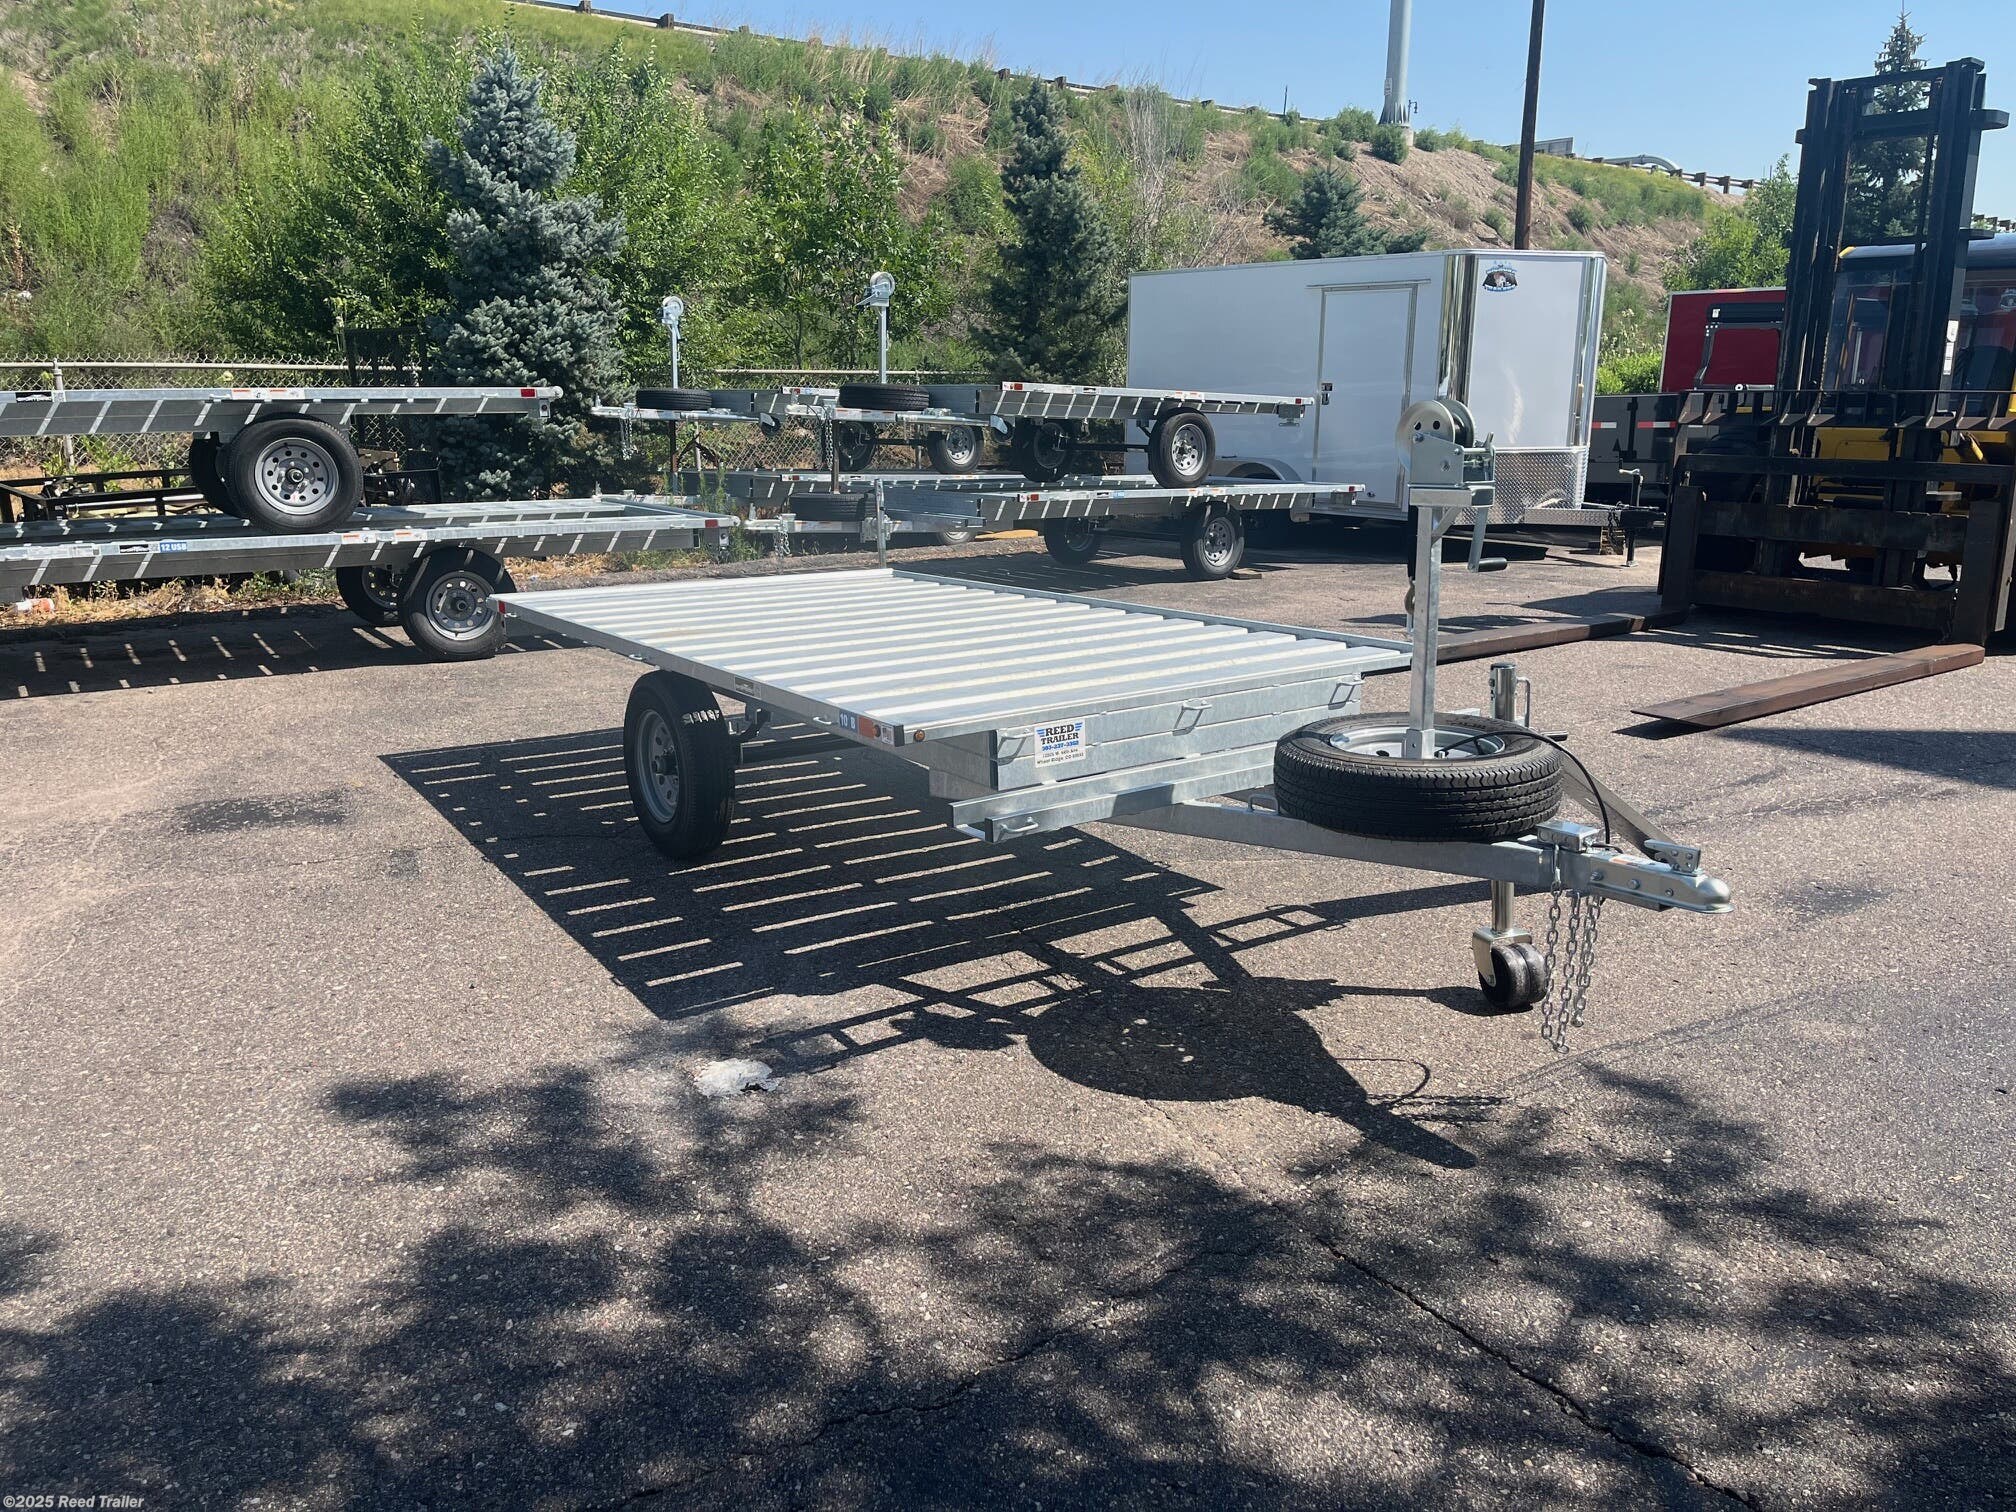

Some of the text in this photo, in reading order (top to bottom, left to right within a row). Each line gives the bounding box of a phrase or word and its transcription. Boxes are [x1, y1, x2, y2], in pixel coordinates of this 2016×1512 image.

[161, 543, 187, 551] 12 USB
[1045, 724, 1075, 736] REED
[1041, 732, 1079, 745] TRAILER
